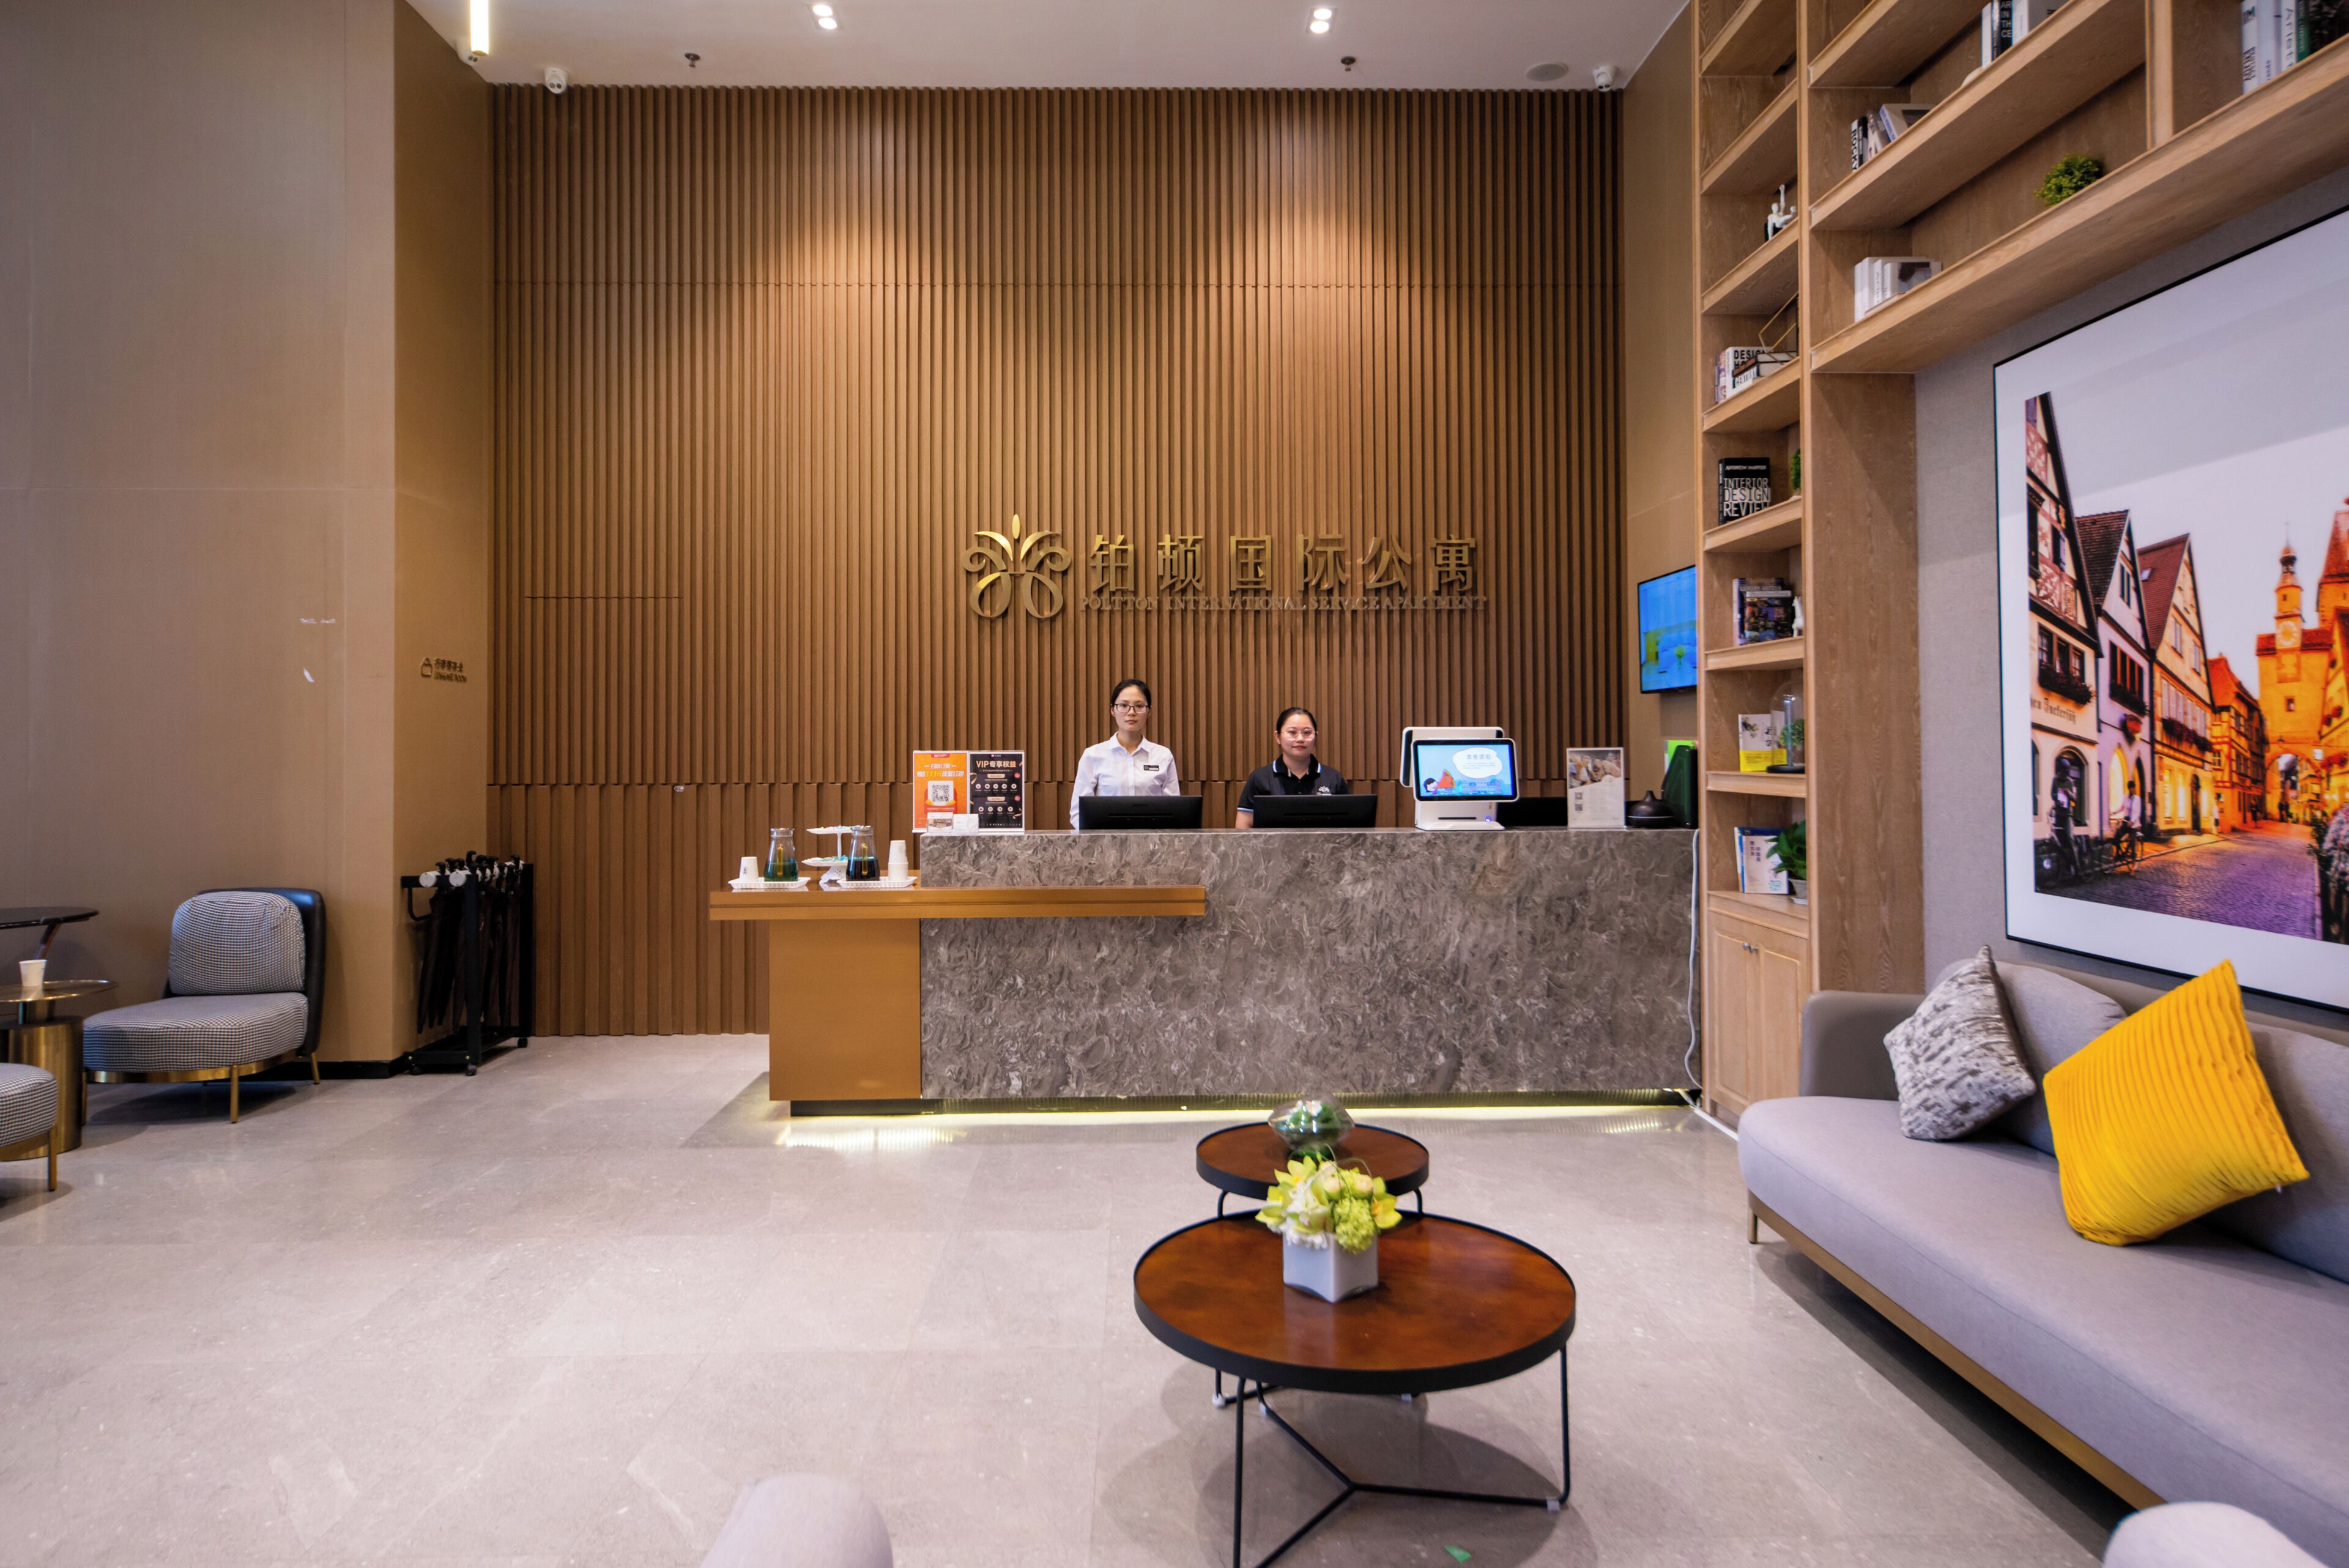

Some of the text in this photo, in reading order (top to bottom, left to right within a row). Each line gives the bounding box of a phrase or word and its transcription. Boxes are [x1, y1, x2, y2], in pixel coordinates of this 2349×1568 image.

[1723, 478, 1769, 488] INTERIOR
[1724, 488, 1770, 502] DESIGN
[1089, 533, 1476, 593] 铂顿国际公寓
[1080, 596, 1486, 610] POLTTON INTERNATIONAL SERVICE APARTMENT
